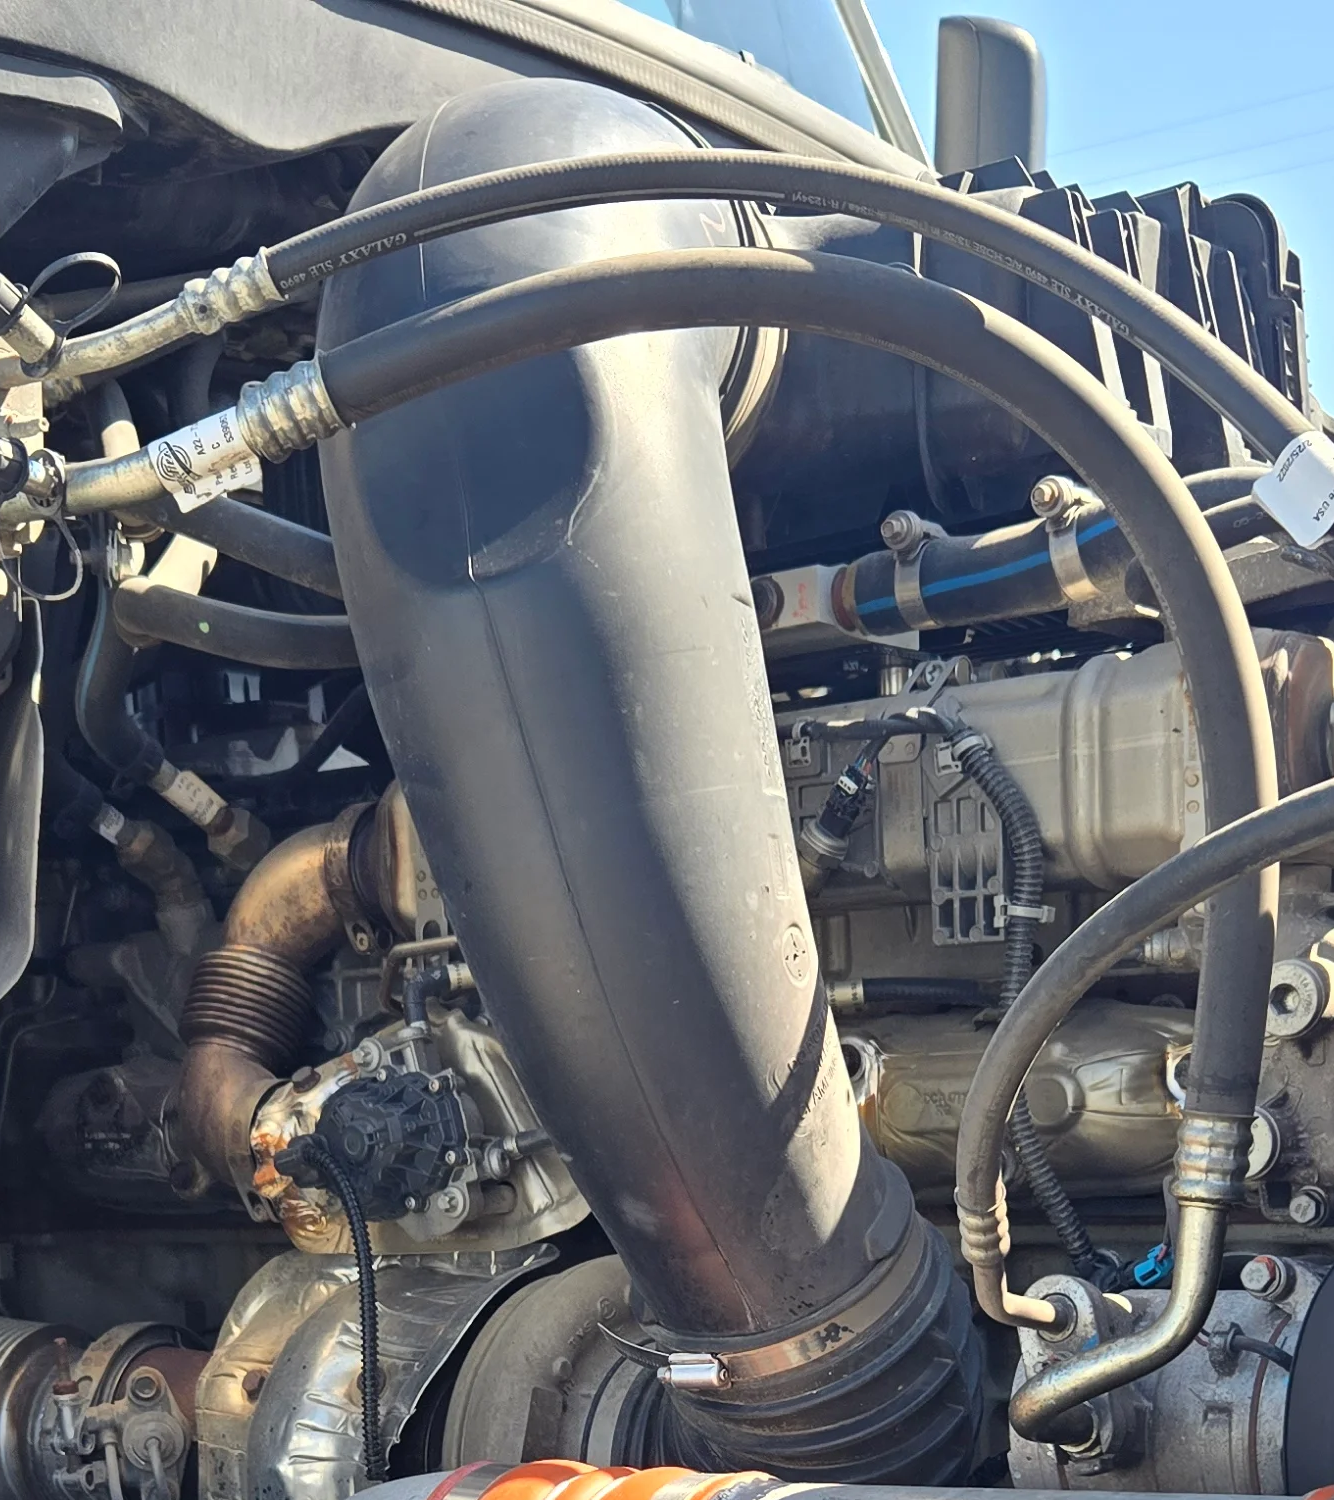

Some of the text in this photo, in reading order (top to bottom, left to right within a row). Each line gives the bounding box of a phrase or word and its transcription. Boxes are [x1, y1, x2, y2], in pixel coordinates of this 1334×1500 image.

[337, 232, 407, 267] GALAXY
[308, 259, 334, 278] SLE
[1051, 278, 1072, 299] SLE
[1075, 293, 1130, 336] GALAXY
[1312, 501, 1331, 522] USA
